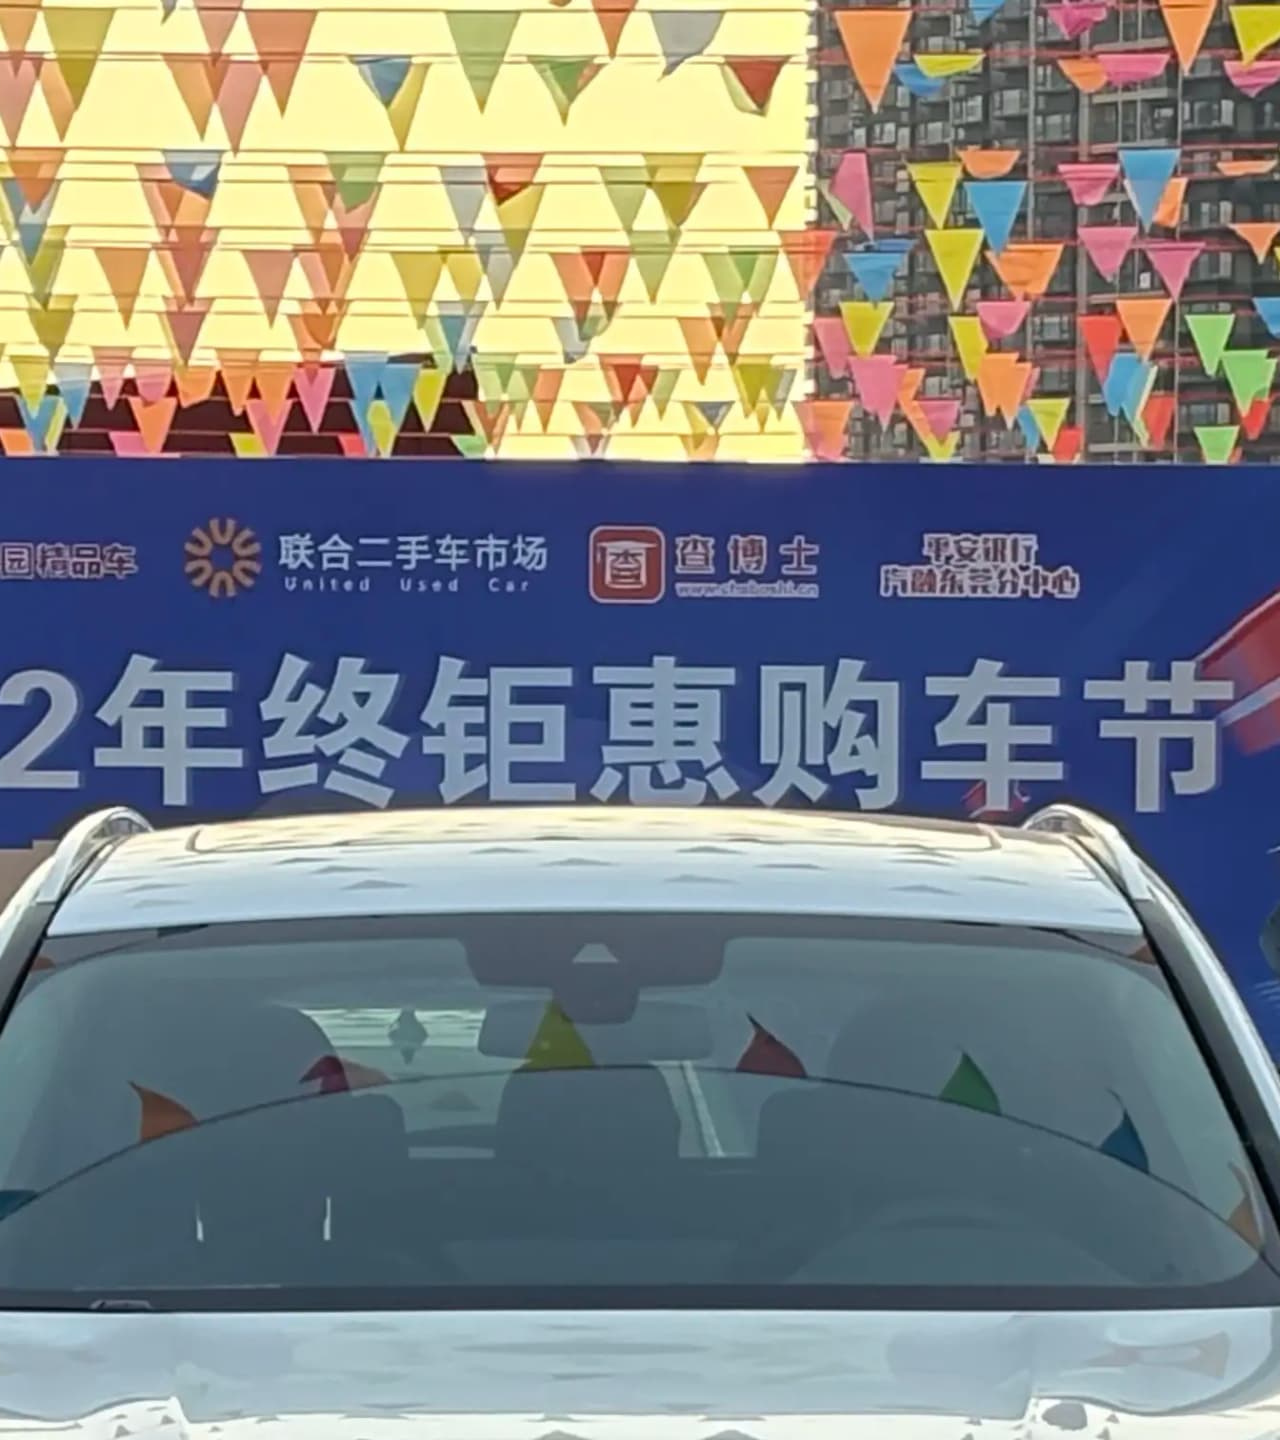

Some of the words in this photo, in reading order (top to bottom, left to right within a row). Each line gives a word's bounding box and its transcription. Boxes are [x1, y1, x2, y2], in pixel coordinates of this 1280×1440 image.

[278, 533, 548, 571] 联合二手车市场
[675, 534, 820, 574] 查博士
[923, 534, 1037, 565] 平安银行
[284, 576, 370, 592] United
[400, 577, 459, 592] Used
[488, 577, 528, 592] Car
